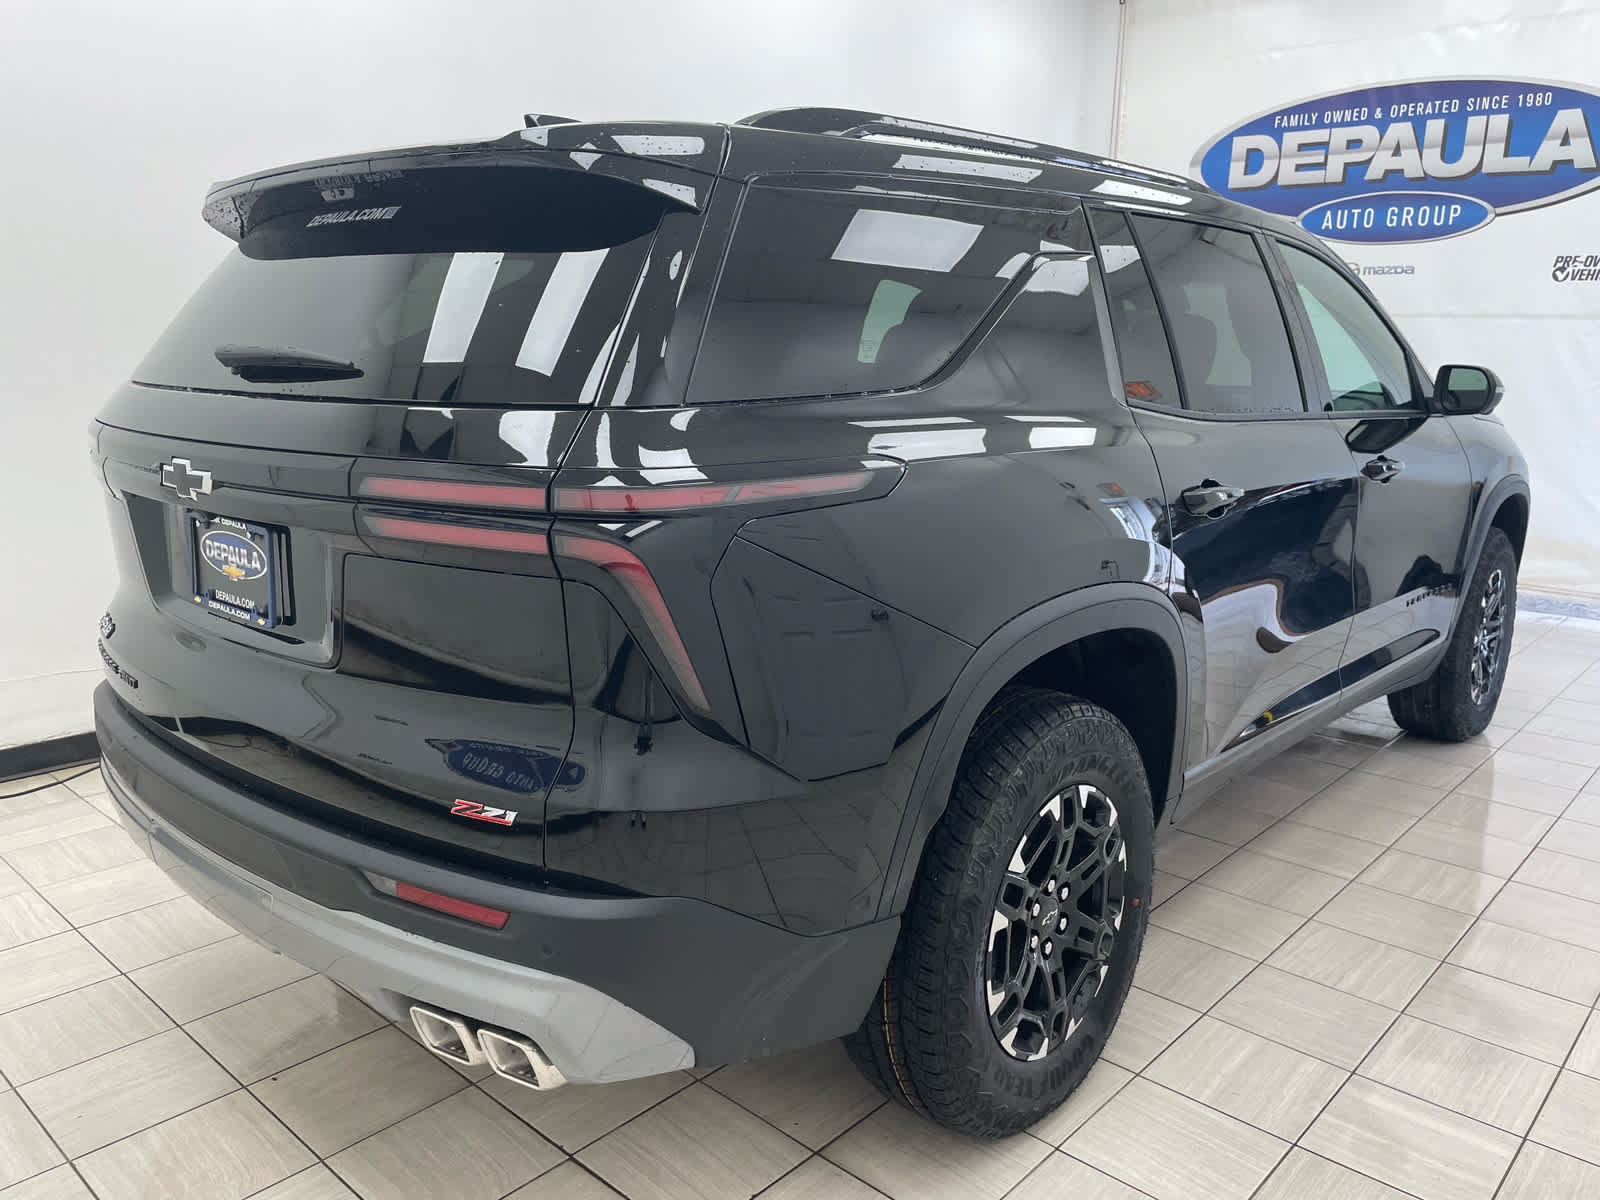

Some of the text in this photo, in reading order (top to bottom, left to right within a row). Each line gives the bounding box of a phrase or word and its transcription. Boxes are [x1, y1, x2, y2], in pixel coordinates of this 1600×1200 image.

[1275, 92, 1553, 129] FAMILY OWNED & OPERATED SINCE 1980
[1227, 108, 1599, 191] DEPAULA
[1321, 204, 1462, 231] AUTO GROUP
[205, 539, 262, 571] DEPAULA
[208, 600, 251, 620] DEPAULA.COM
[215, 589, 256, 609] DEPAULA.COM
[451, 798, 519, 826] Z71
